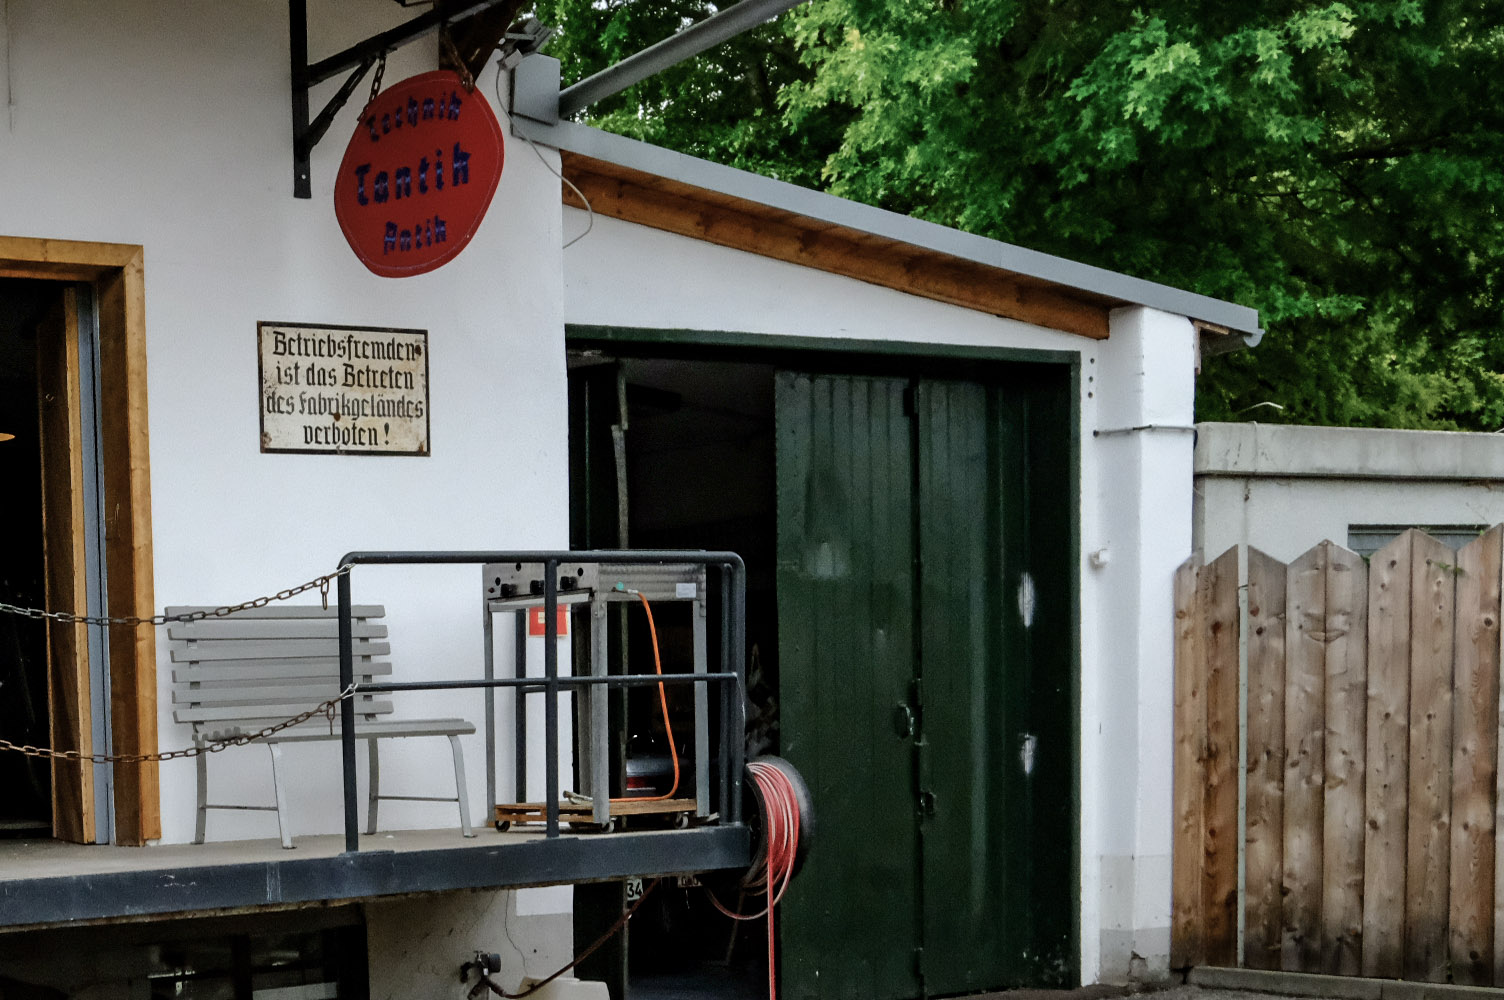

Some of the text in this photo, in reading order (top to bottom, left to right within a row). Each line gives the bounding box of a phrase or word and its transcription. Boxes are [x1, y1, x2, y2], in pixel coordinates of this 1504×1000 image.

[365, 90, 463, 142] Technik
[384, 215, 447, 255] Antik
[272, 331, 416, 361] Betriebsfremden
[276, 361, 414, 390] ist das Betreten
[266, 391, 424, 421] des Fabrikgeländes
